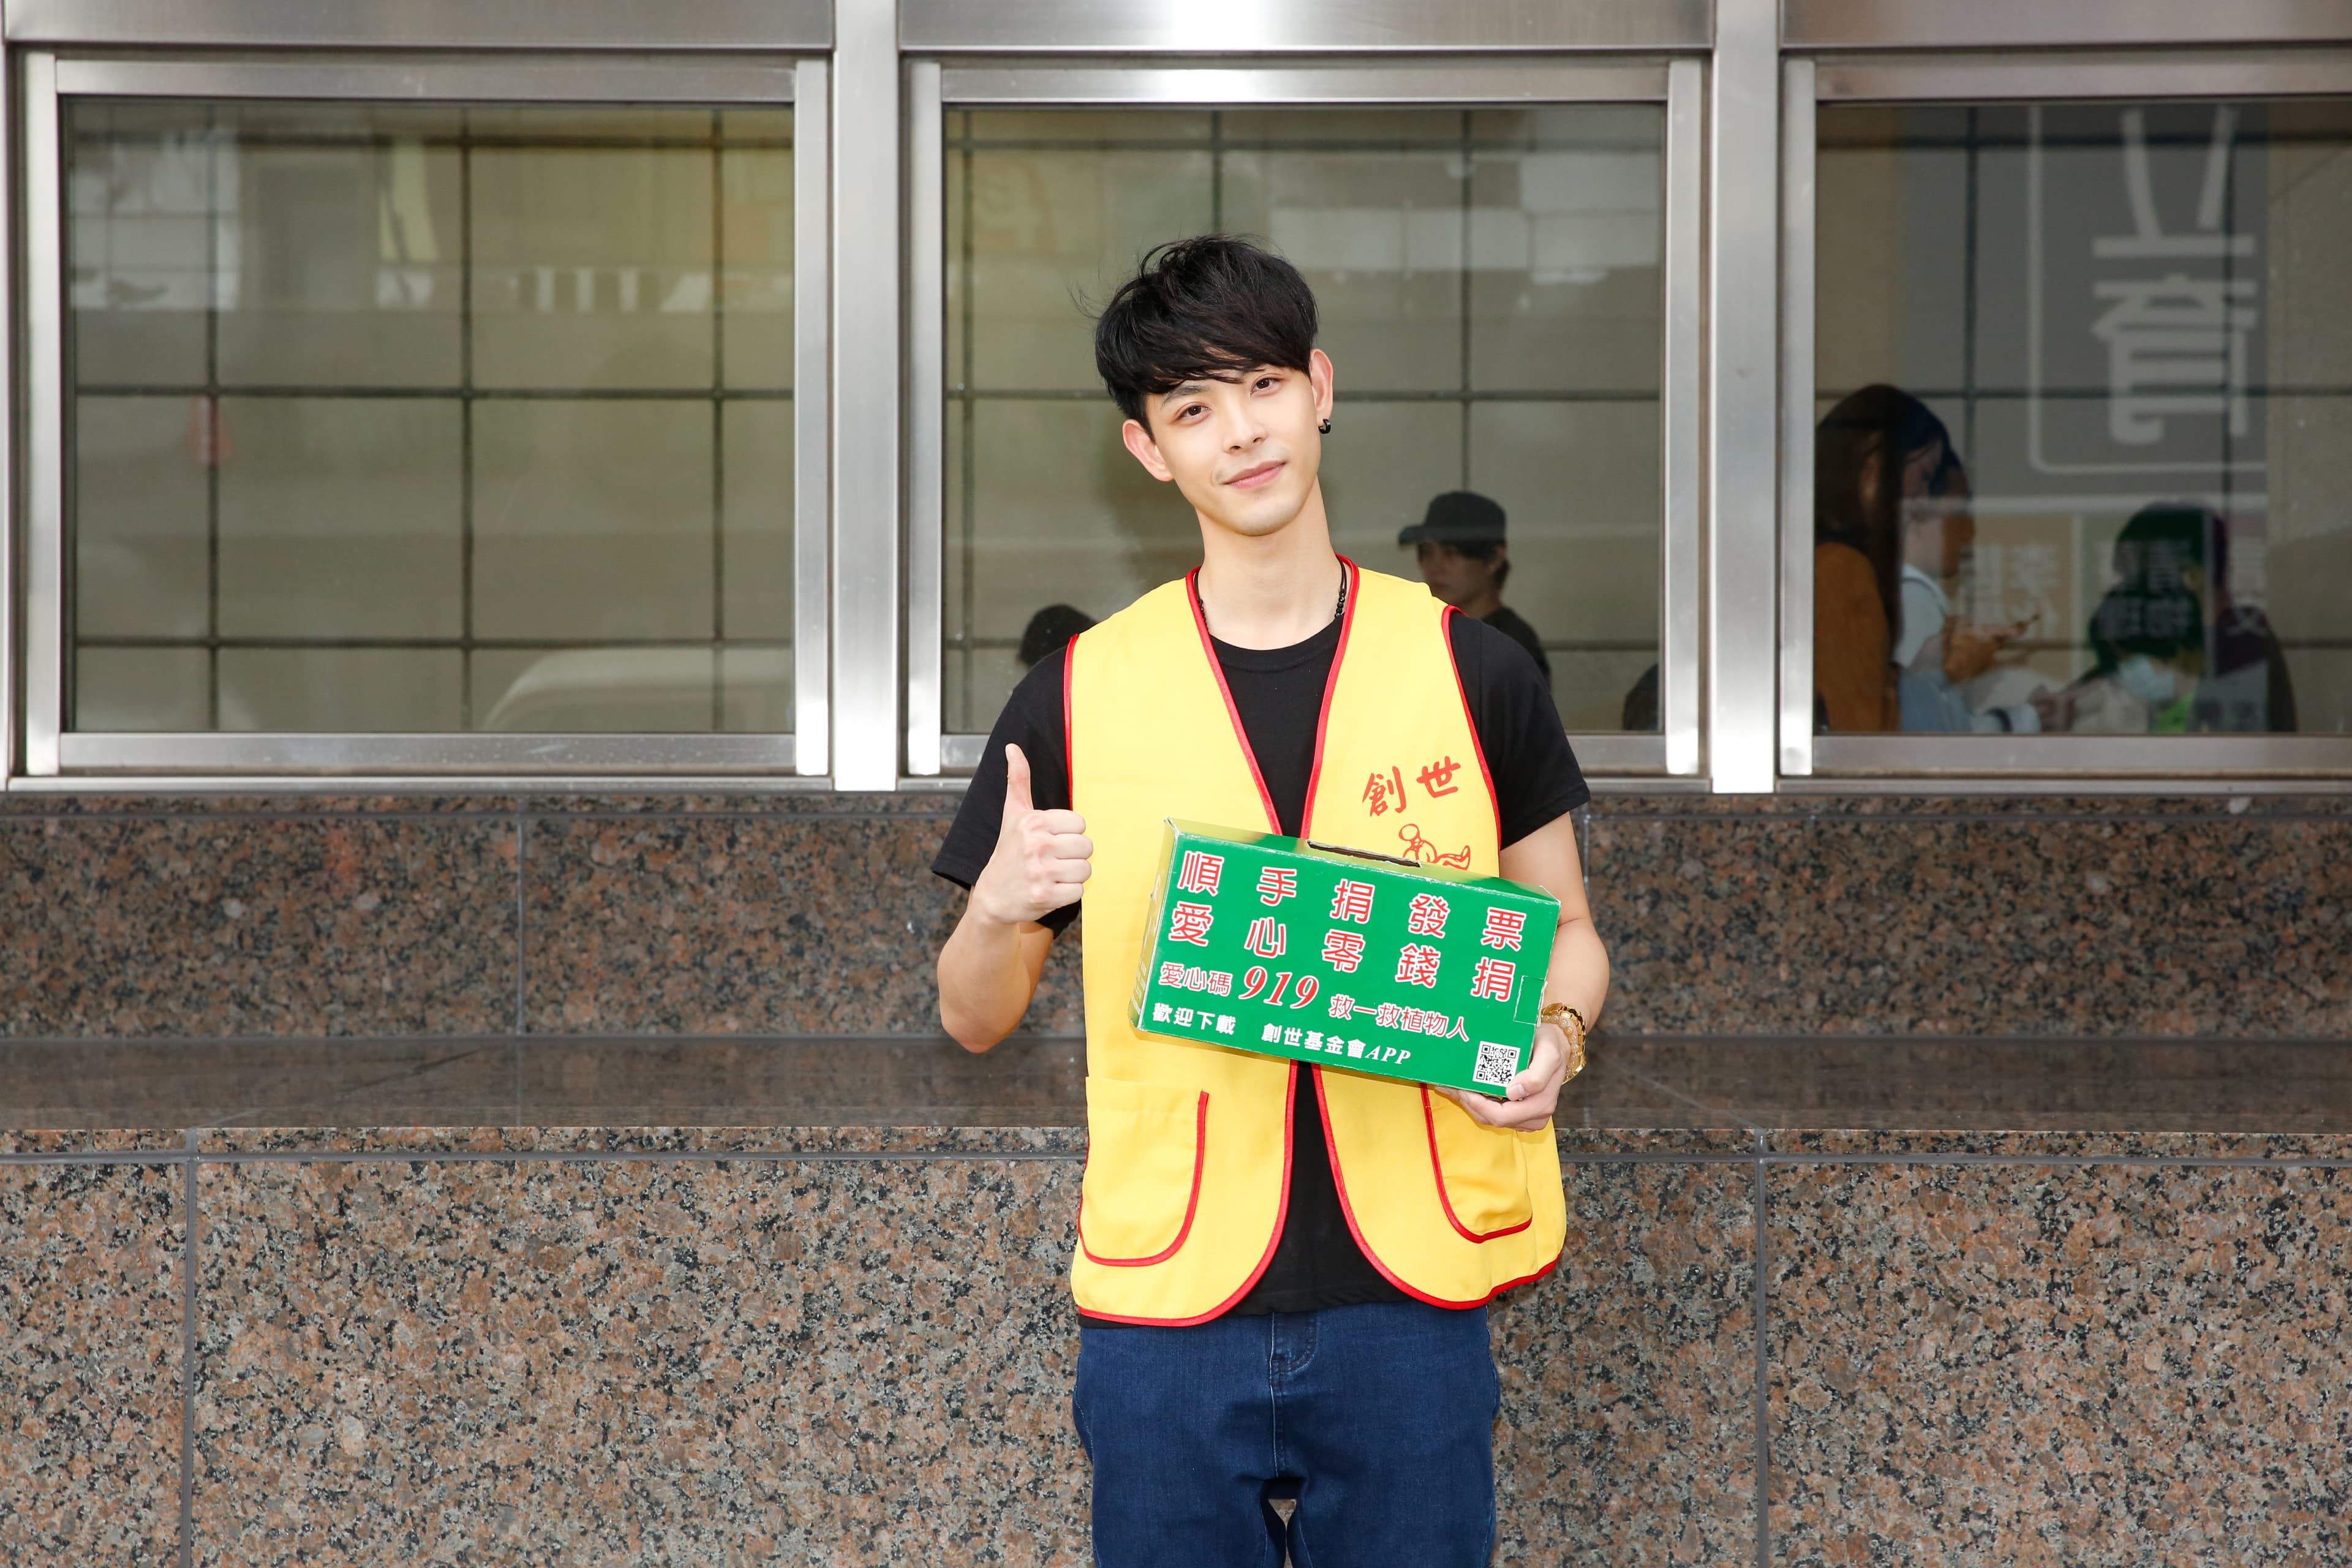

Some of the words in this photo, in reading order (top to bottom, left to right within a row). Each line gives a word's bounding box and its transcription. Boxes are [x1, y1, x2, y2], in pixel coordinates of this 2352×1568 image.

[1362, 756, 1461, 817] 創世
[1177, 850, 1527, 952] 順手捐發票
[1168, 901, 1517, 1003] 愛心零錢捐
[1152, 1003, 1236, 1035] 歡迎下載
[1159, 961, 1233, 997] 愛心碼
[1238, 965, 1319, 1009] 919
[1329, 993, 1469, 1042] 救一救植物人
